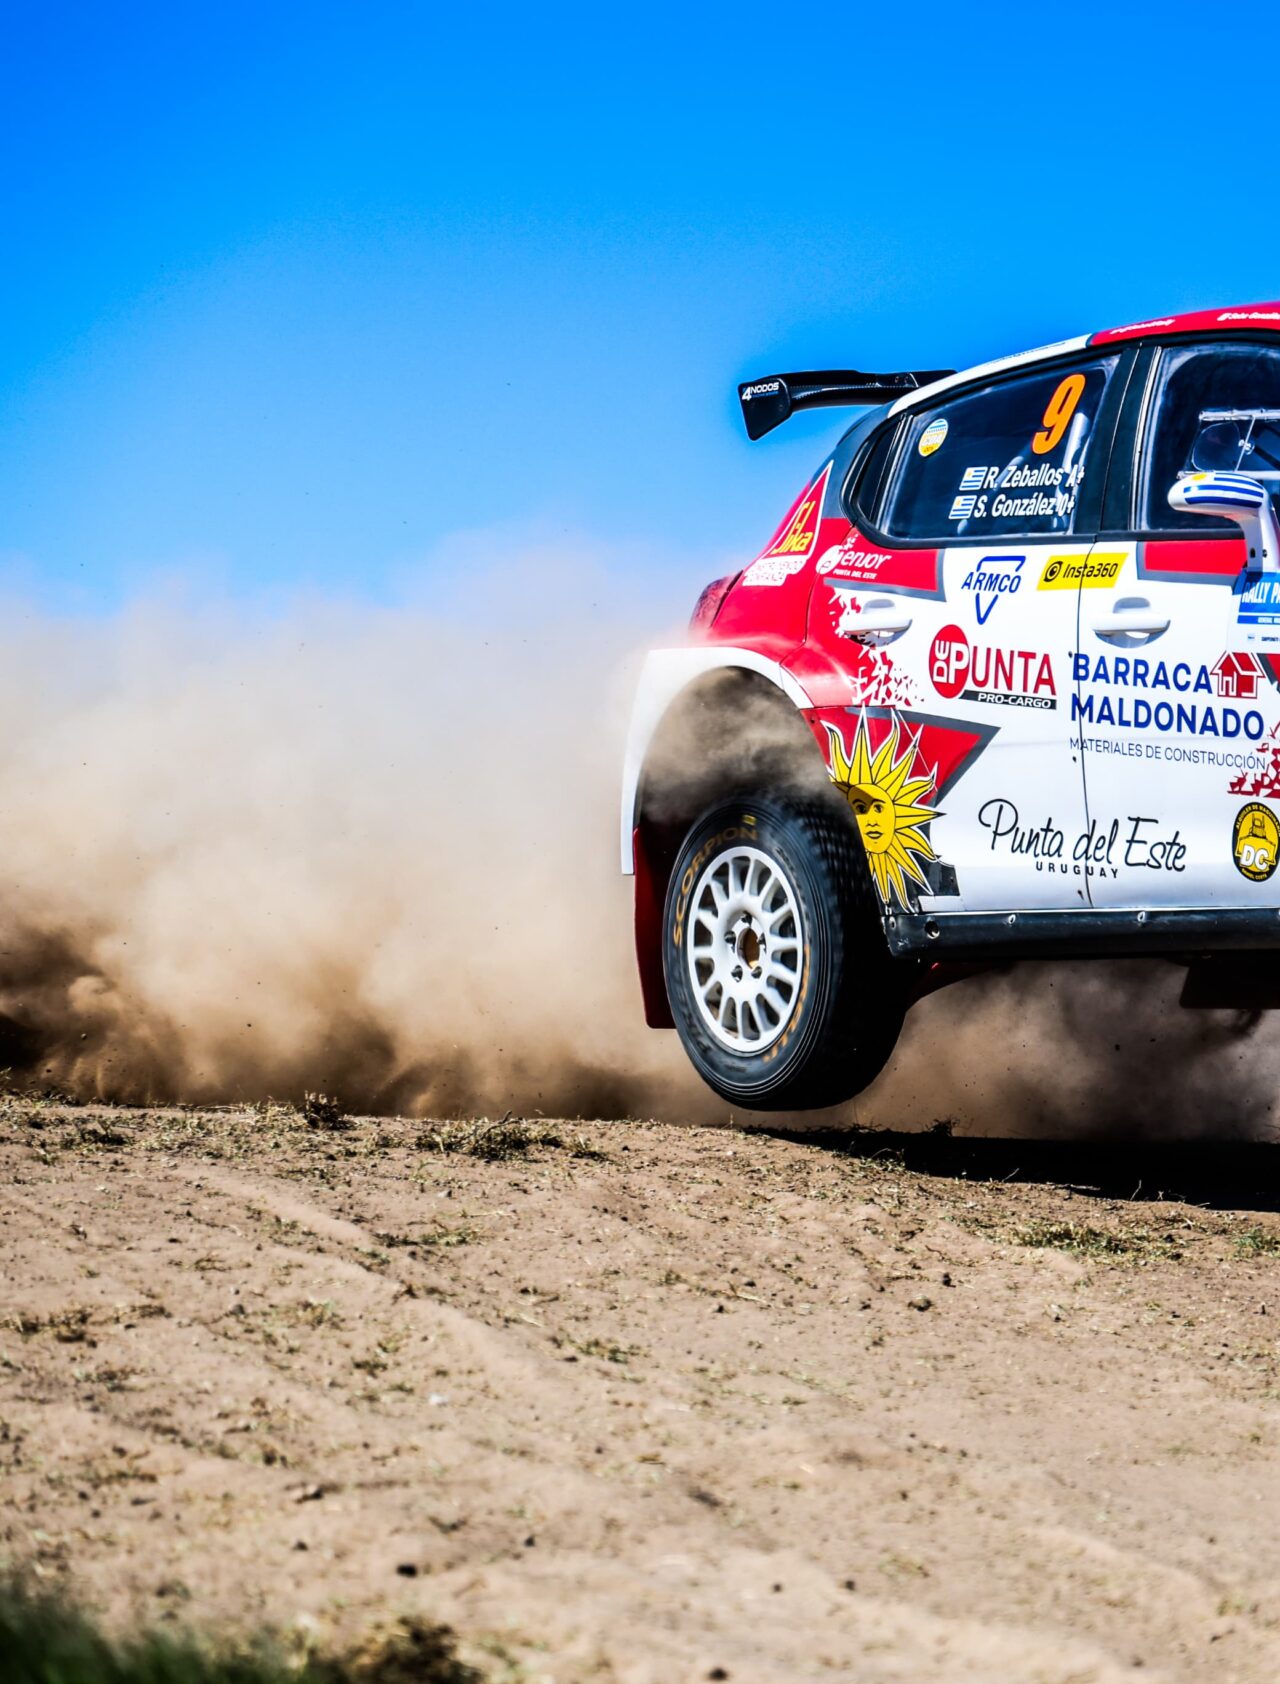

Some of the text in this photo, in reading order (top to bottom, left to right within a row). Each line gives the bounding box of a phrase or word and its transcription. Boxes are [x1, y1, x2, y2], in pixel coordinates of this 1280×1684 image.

[1032, 374, 1086, 455] 9
[984, 466, 999, 489] R.
[1001, 463, 1064, 488] Zeballos
[974, 495, 987, 518] S.
[991, 492, 1056, 518] González
[961, 571, 1021, 593] ARMCO
[1063, 563, 1119, 579] Insta360
[1242, 582, 1271, 603] RALLY
[1072, 653, 1213, 695] BARRACA
[977, 692, 1052, 709] PRO-CARGO
[1071, 693, 1264, 740] MALDONADO
[1070, 737, 1266, 772] MATERIALES DE CONSTRUCCIÓN
[978, 798, 1187, 872] Punta del Este
[1035, 861, 1118, 879] URUGUAY
[1240, 844, 1269, 871] DC
[673, 827, 758, 949] SCORPION
